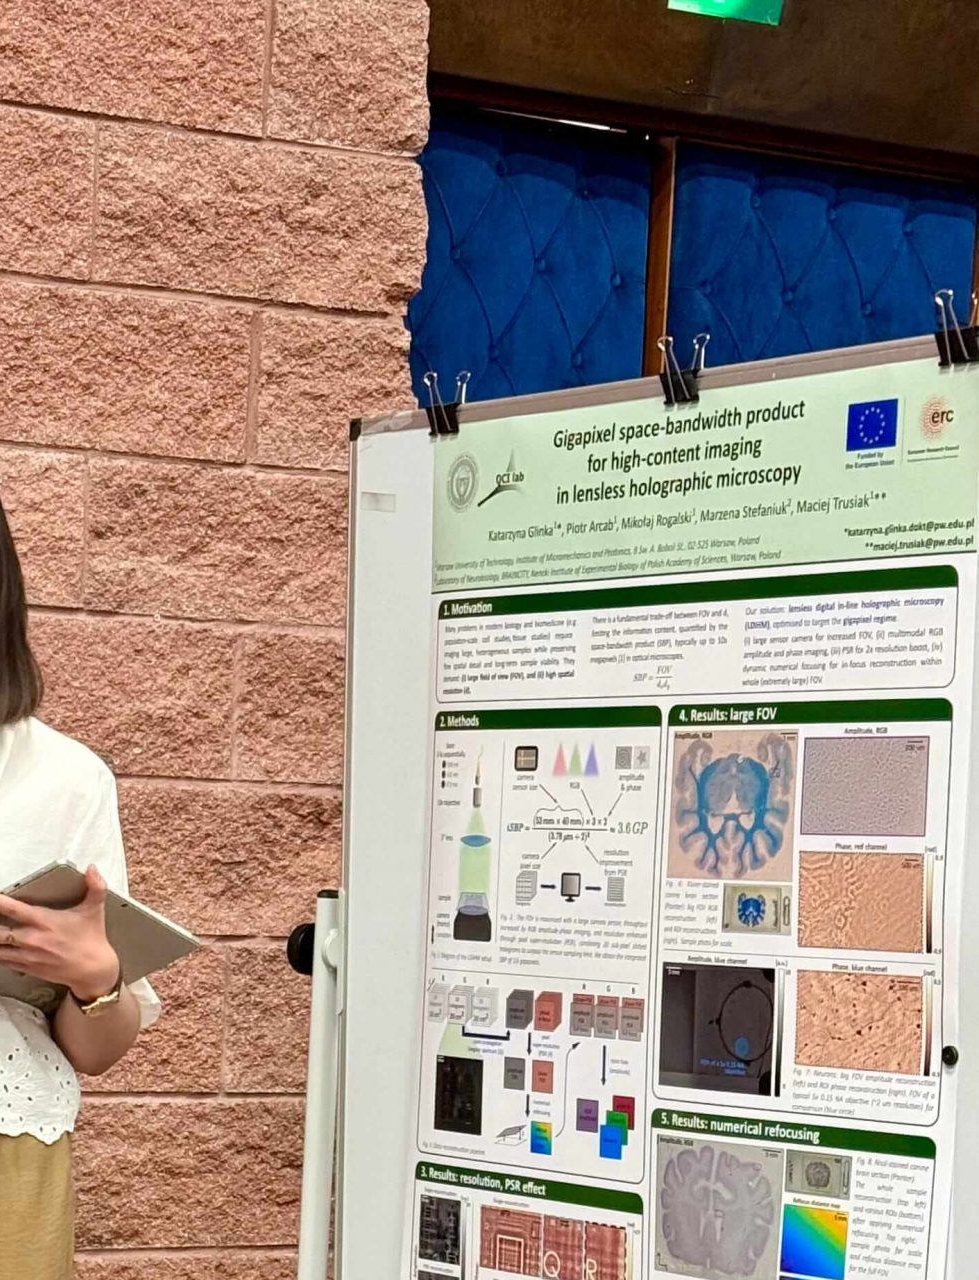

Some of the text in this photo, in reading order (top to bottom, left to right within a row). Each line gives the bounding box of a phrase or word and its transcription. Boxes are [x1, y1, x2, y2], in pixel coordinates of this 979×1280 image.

[553, 400, 805, 450] Gigapixel space-bandwidth product
[932, 409, 954, 424] erc
[588, 436, 762, 473] for high-content imaging
[557, 465, 801, 504] in lensless holographic microscopy
[488, 530, 526, 542] Katarzyna
[567, 522, 587, 534] Piotr
[700, 509, 740, 523] Marzena
[797, 499, 830, 514] Maciej
[444, 601, 492, 616] 1. Motivation
[861, 598, 901, 610] holographic
[447, 714, 479, 727] Methods
[679, 707, 777, 723] 4. Results: large FOV
[661, 1112, 820, 1144] 5. Results: numerical refocusing
[420, 1166, 546, 1196] 3. Results: resolution, PSR effect
